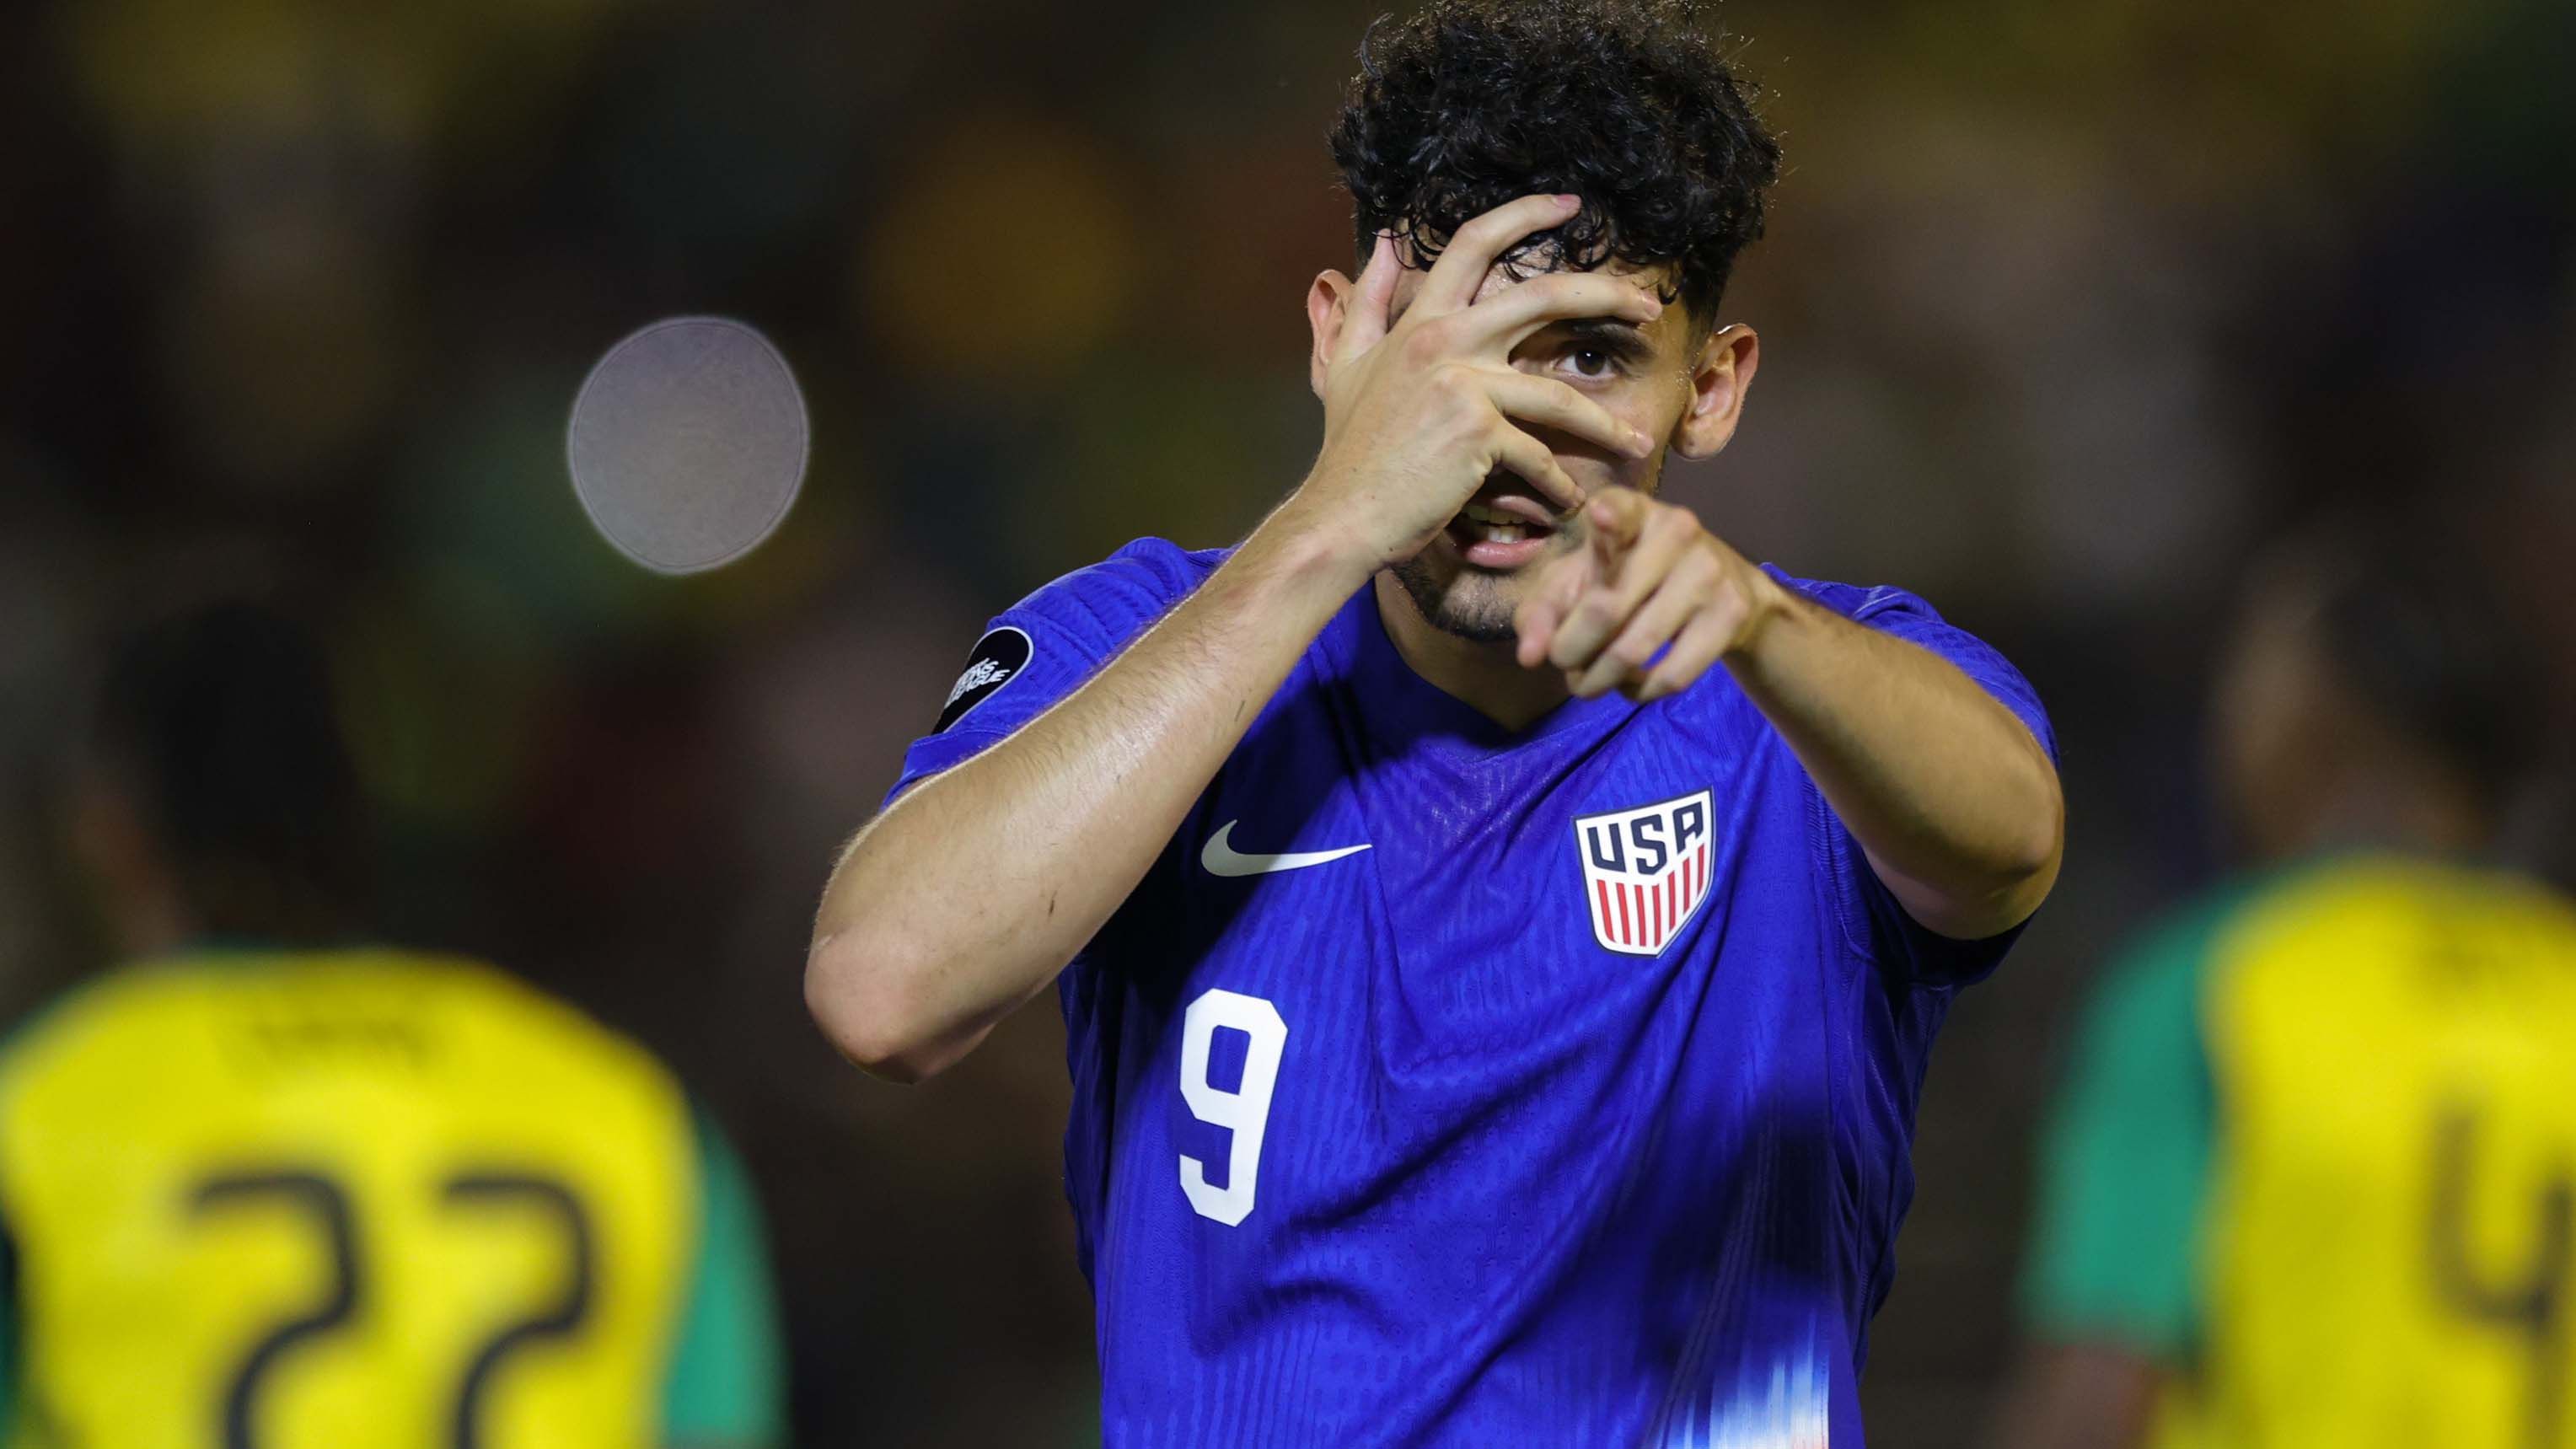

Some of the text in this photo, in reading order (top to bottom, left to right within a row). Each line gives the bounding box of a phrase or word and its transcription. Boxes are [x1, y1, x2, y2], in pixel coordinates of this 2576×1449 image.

[1587, 801, 1704, 876] USA
[1179, 988, 1288, 1227] 9
[187, 1168, 595, 1449] 22
